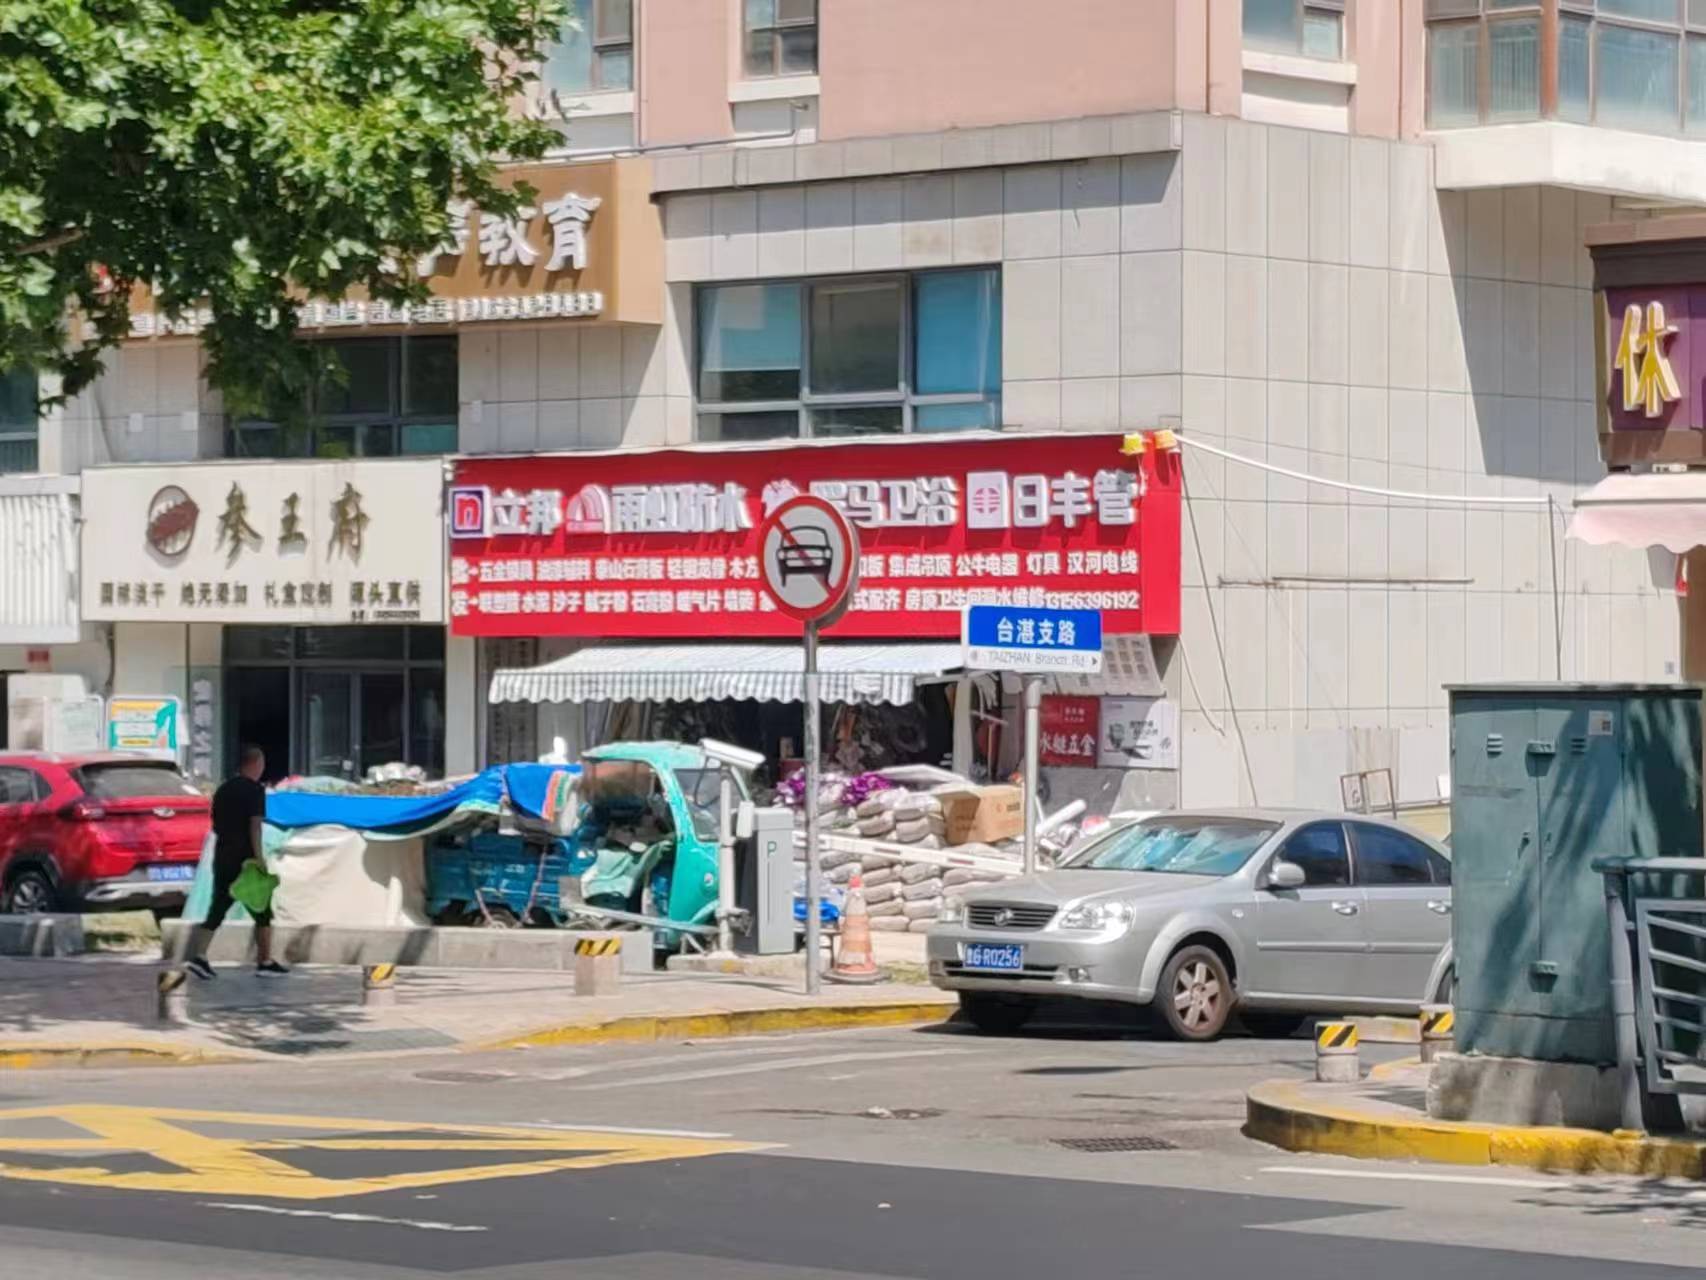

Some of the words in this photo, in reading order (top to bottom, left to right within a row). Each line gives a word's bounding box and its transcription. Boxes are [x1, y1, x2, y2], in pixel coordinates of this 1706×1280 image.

[1615, 300, 1681, 418] 休
[492, 488, 563, 534] 立邦
[611, 481, 752, 533] 雨虹防水
[1012, 470, 1139, 528] 日丰管
[889, 554, 952, 577] 集成吊顶
[956, 552, 1018, 576] 公牛电器
[1026, 551, 1060, 575] 灯具
[1068, 550, 1139, 574] 汉河电线
[848, 588, 900, 612] 式配齐
[988, 651, 1030, 665] TAIZHAN
[1035, 652, 1067, 665] Branch
[767, 841, 777, 858] P
